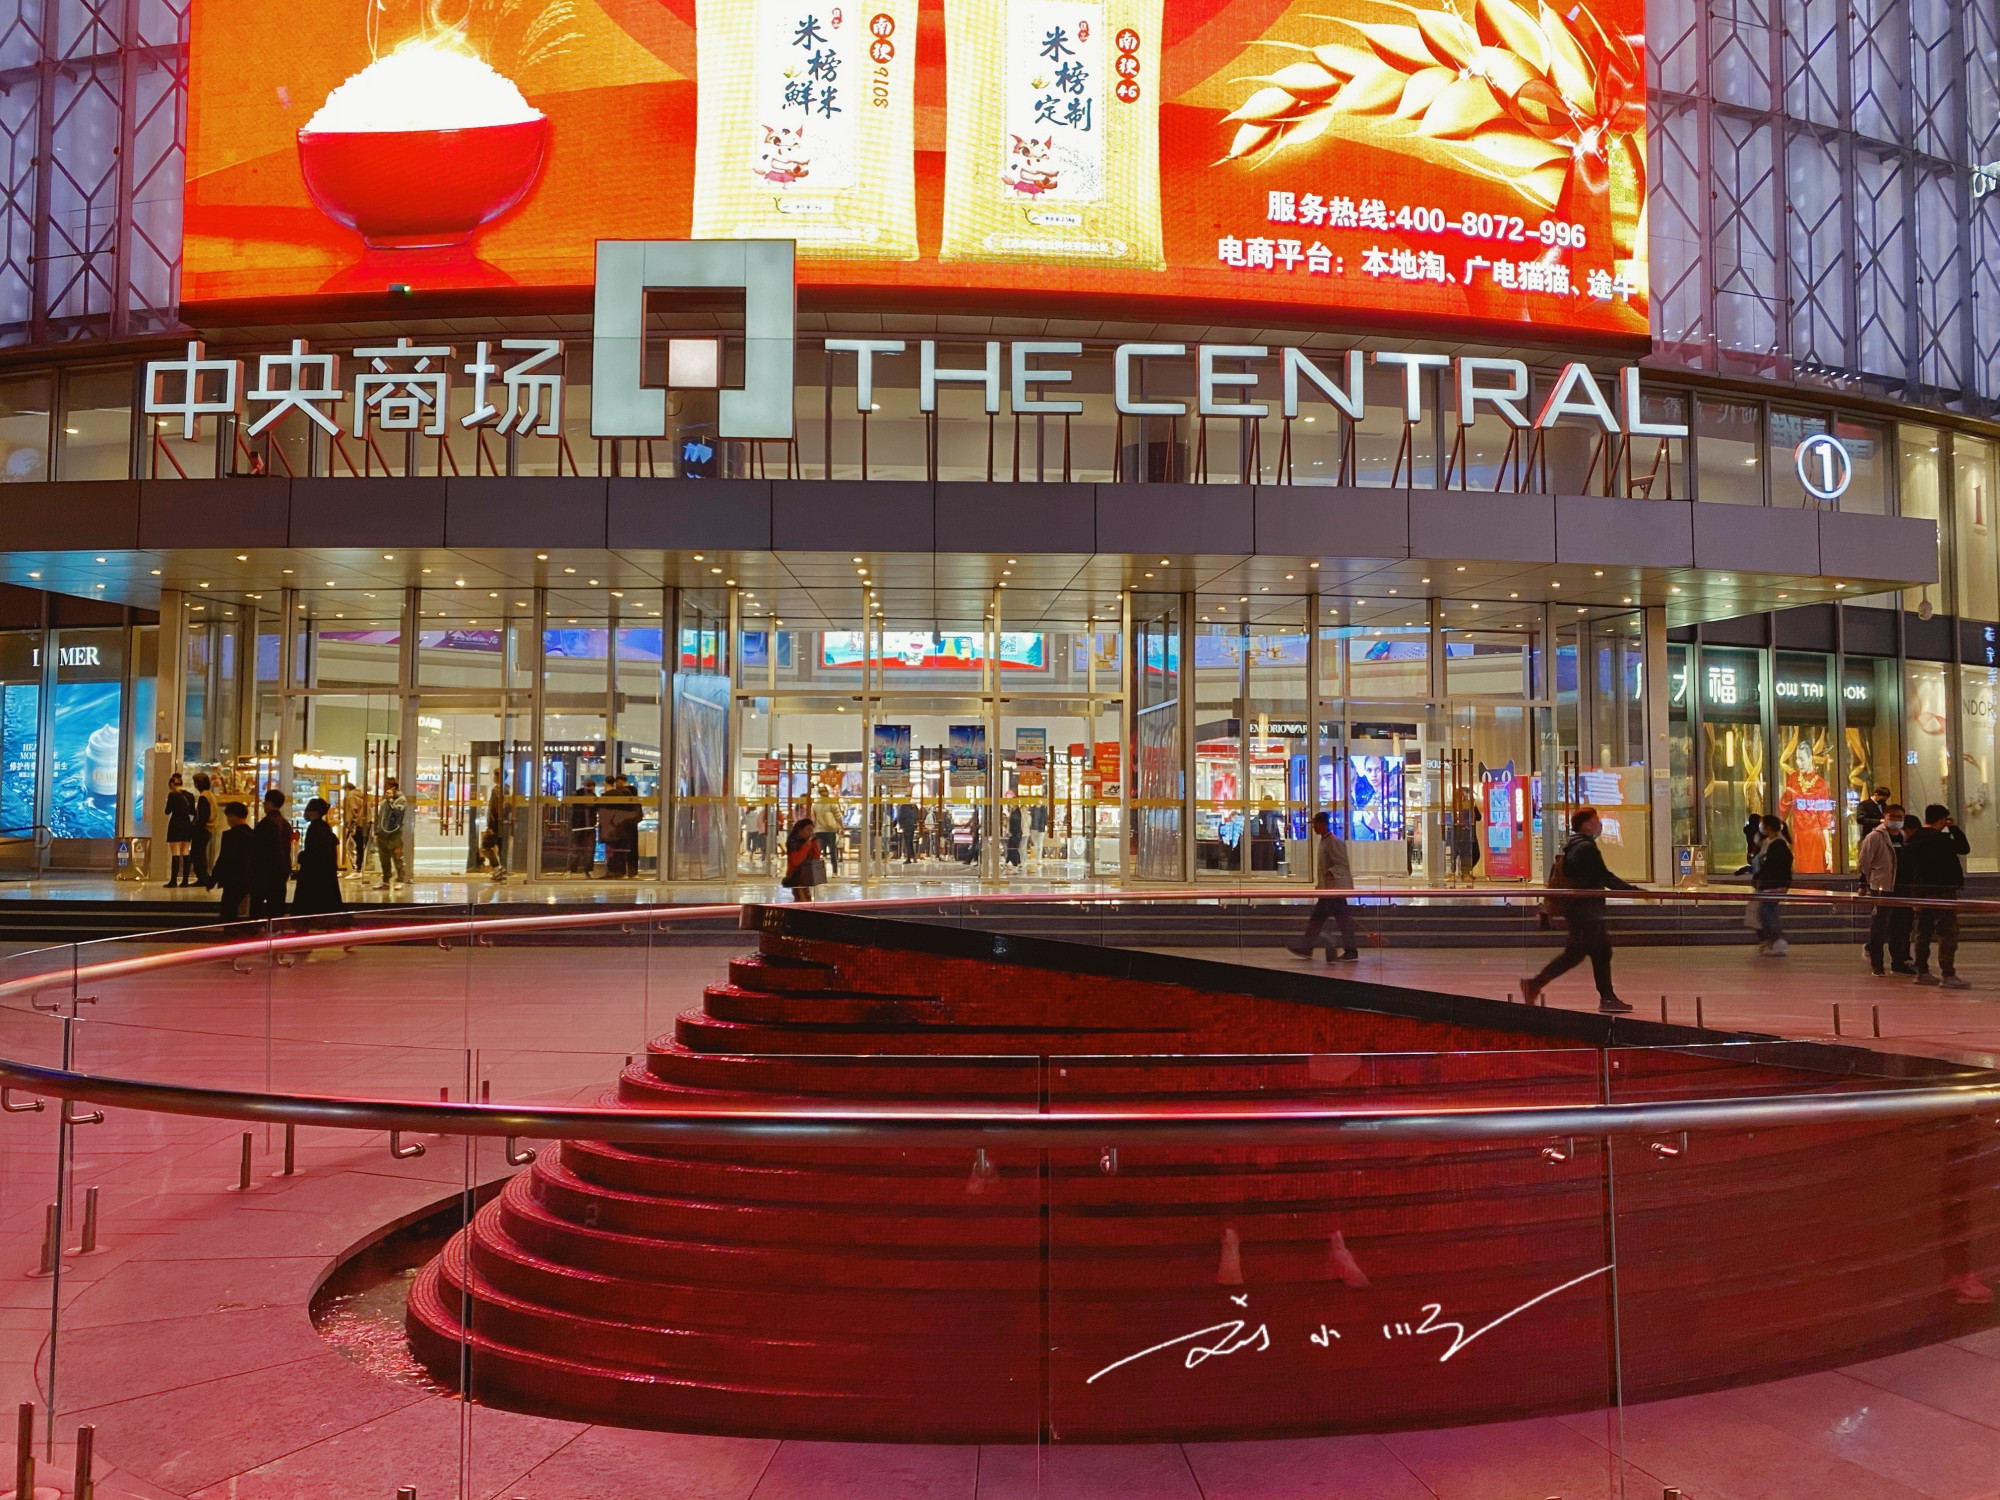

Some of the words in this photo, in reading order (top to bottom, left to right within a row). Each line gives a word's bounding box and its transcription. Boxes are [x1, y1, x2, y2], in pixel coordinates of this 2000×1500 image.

[145, 337, 564, 440] 中央商场
[824, 339, 1084, 415] THE
[1113, 342, 1690, 438] CENTRAL
[59, 646, 101, 666] MER
